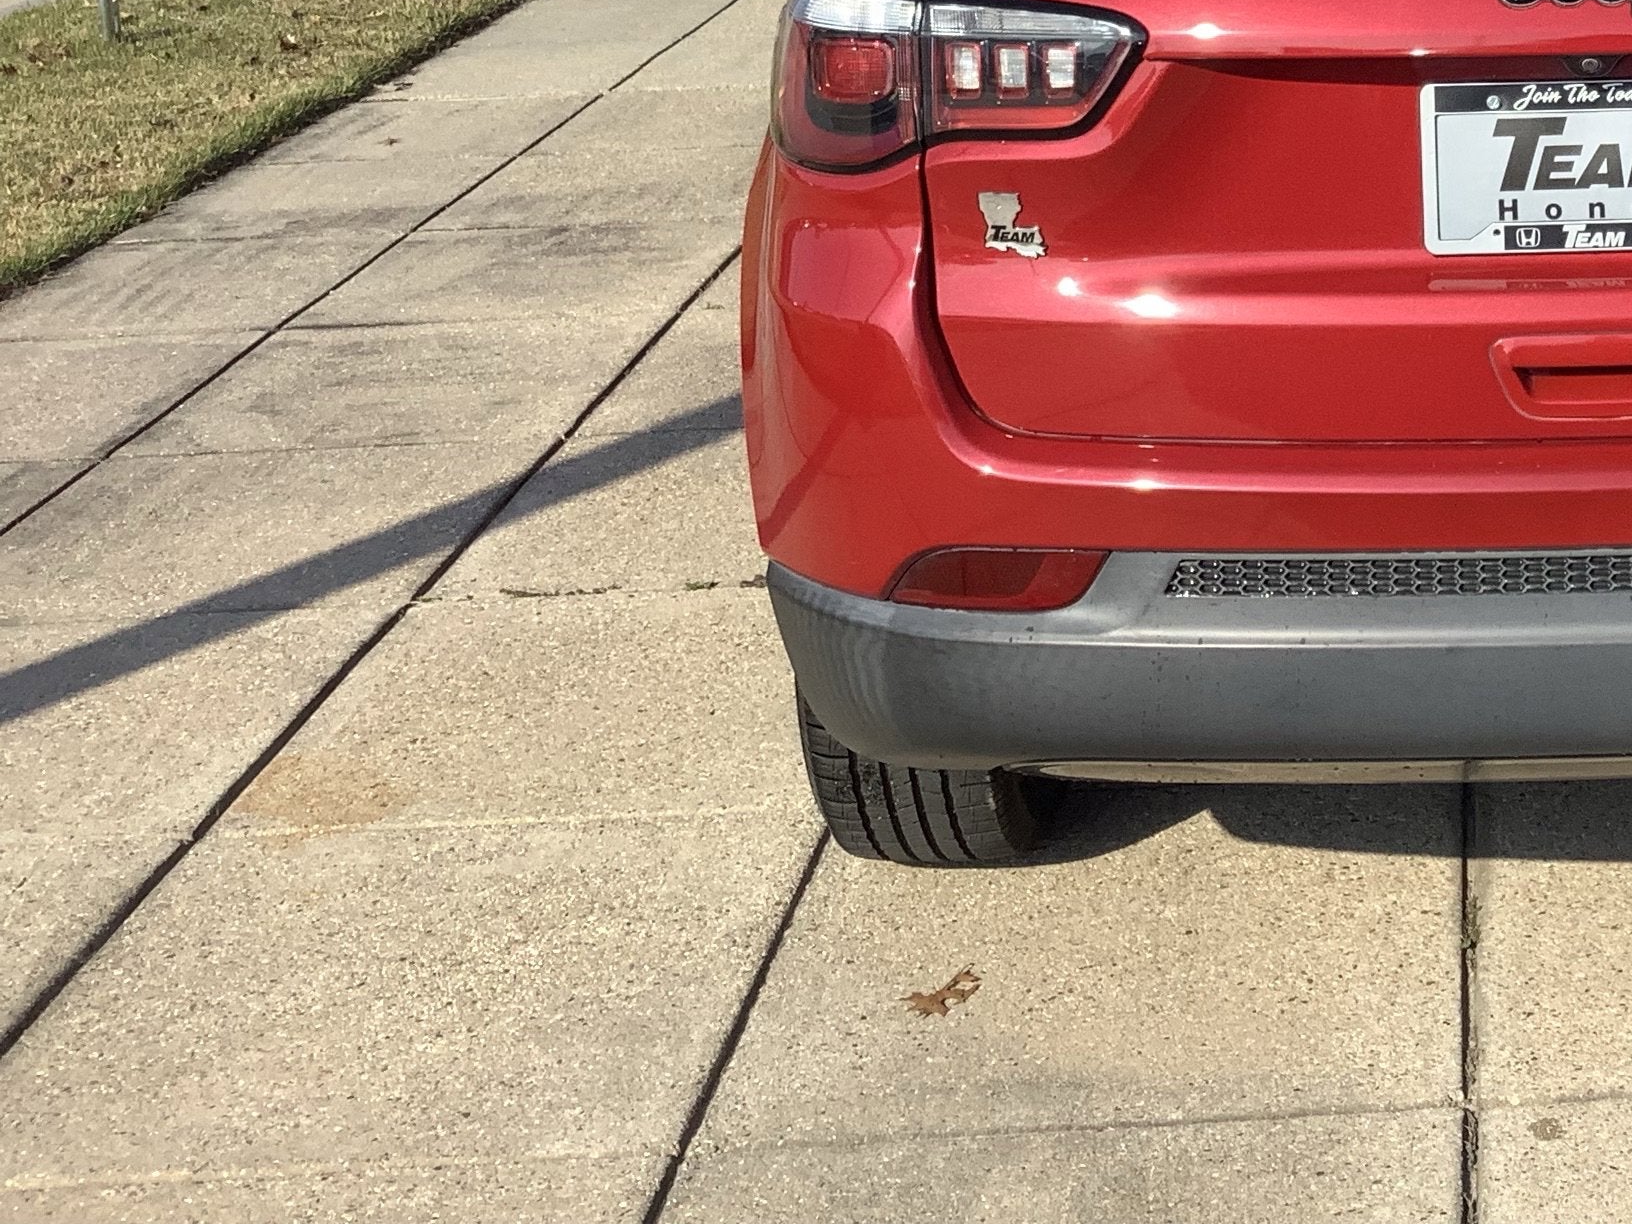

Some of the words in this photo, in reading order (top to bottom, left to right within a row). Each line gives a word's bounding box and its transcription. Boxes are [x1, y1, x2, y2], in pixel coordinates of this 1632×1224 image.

[1513, 84, 1562, 111] Join
[1563, 84, 1600, 104] The
[990, 225, 1035, 243] TEAM
[1561, 224, 1626, 248] TEAM
